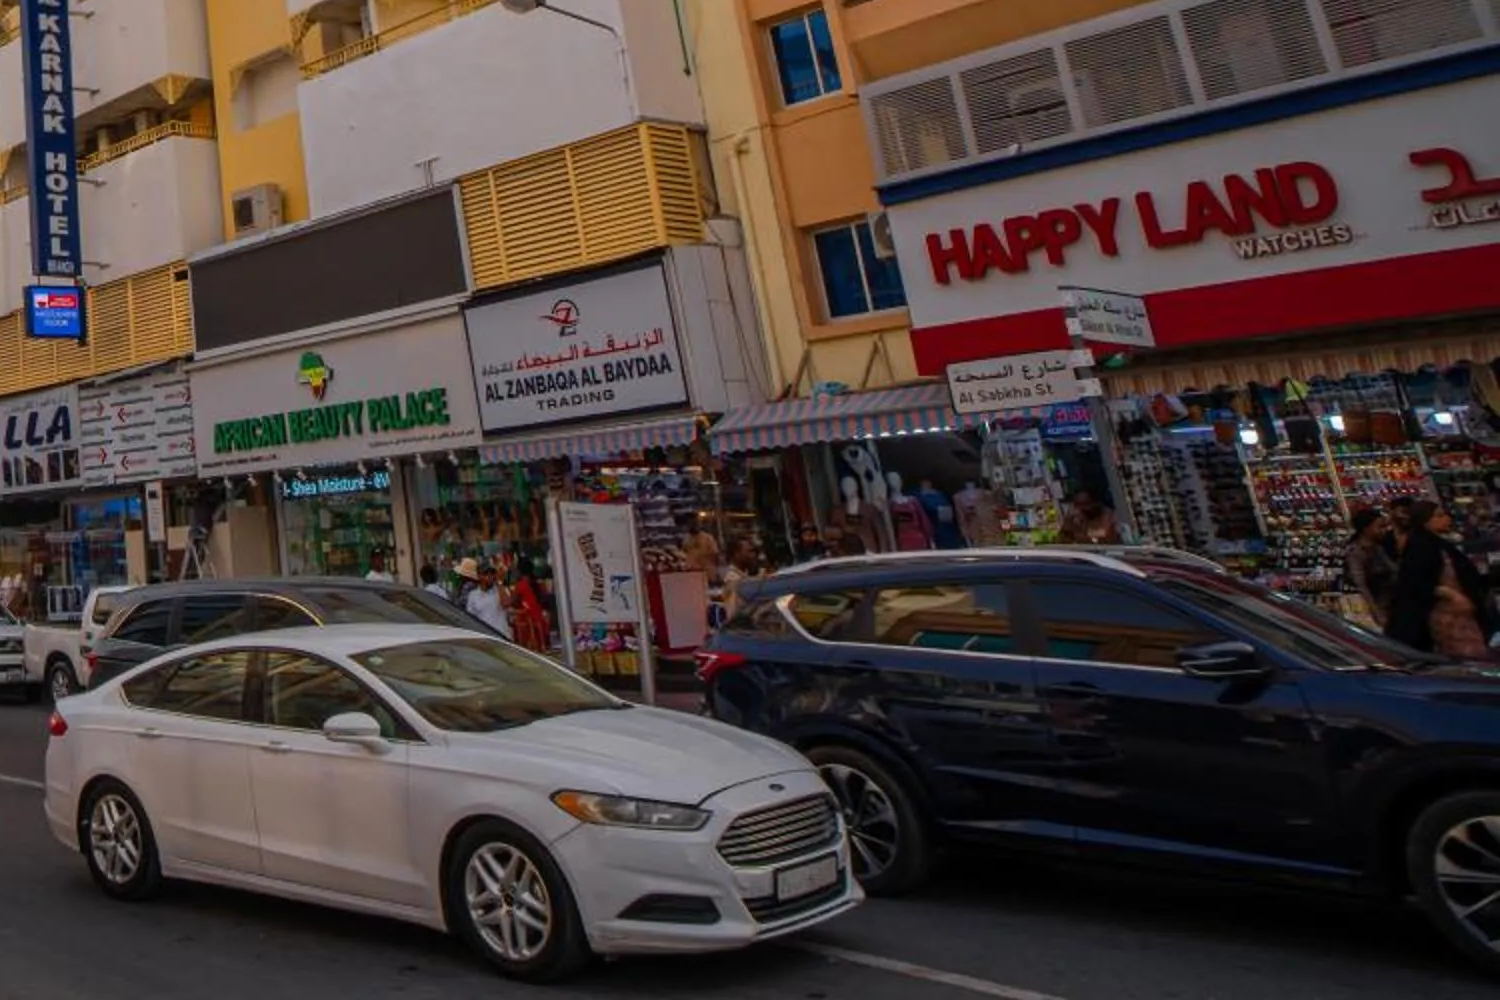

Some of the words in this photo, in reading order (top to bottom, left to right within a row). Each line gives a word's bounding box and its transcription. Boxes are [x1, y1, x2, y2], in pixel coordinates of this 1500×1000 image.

[38, 13, 67, 135] KARNAK
[45, 152, 70, 257] HOTEL
[925, 197, 1122, 286] HAPPY
[1134, 161, 1339, 250] LAND
[1235, 224, 1353, 259] WATCHES
[485, 384, 504, 403] AL
[505, 369, 580, 398] ZANBAQA
[581, 367, 601, 385] AL
[603, 353, 673, 383] BAYDAA
[1021, 359, 1066, 381] شارع
[536, 389, 616, 411] TRADING
[959, 392, 974, 406] Al
[977, 386, 1032, 403] Sabkha
[1035, 383, 1054, 397] St
[4, 405, 71, 450] LLA
[214, 412, 288, 454] AFRICAN
[288, 400, 365, 443] BEAUTY
[368, 387, 451, 433] PALACE
